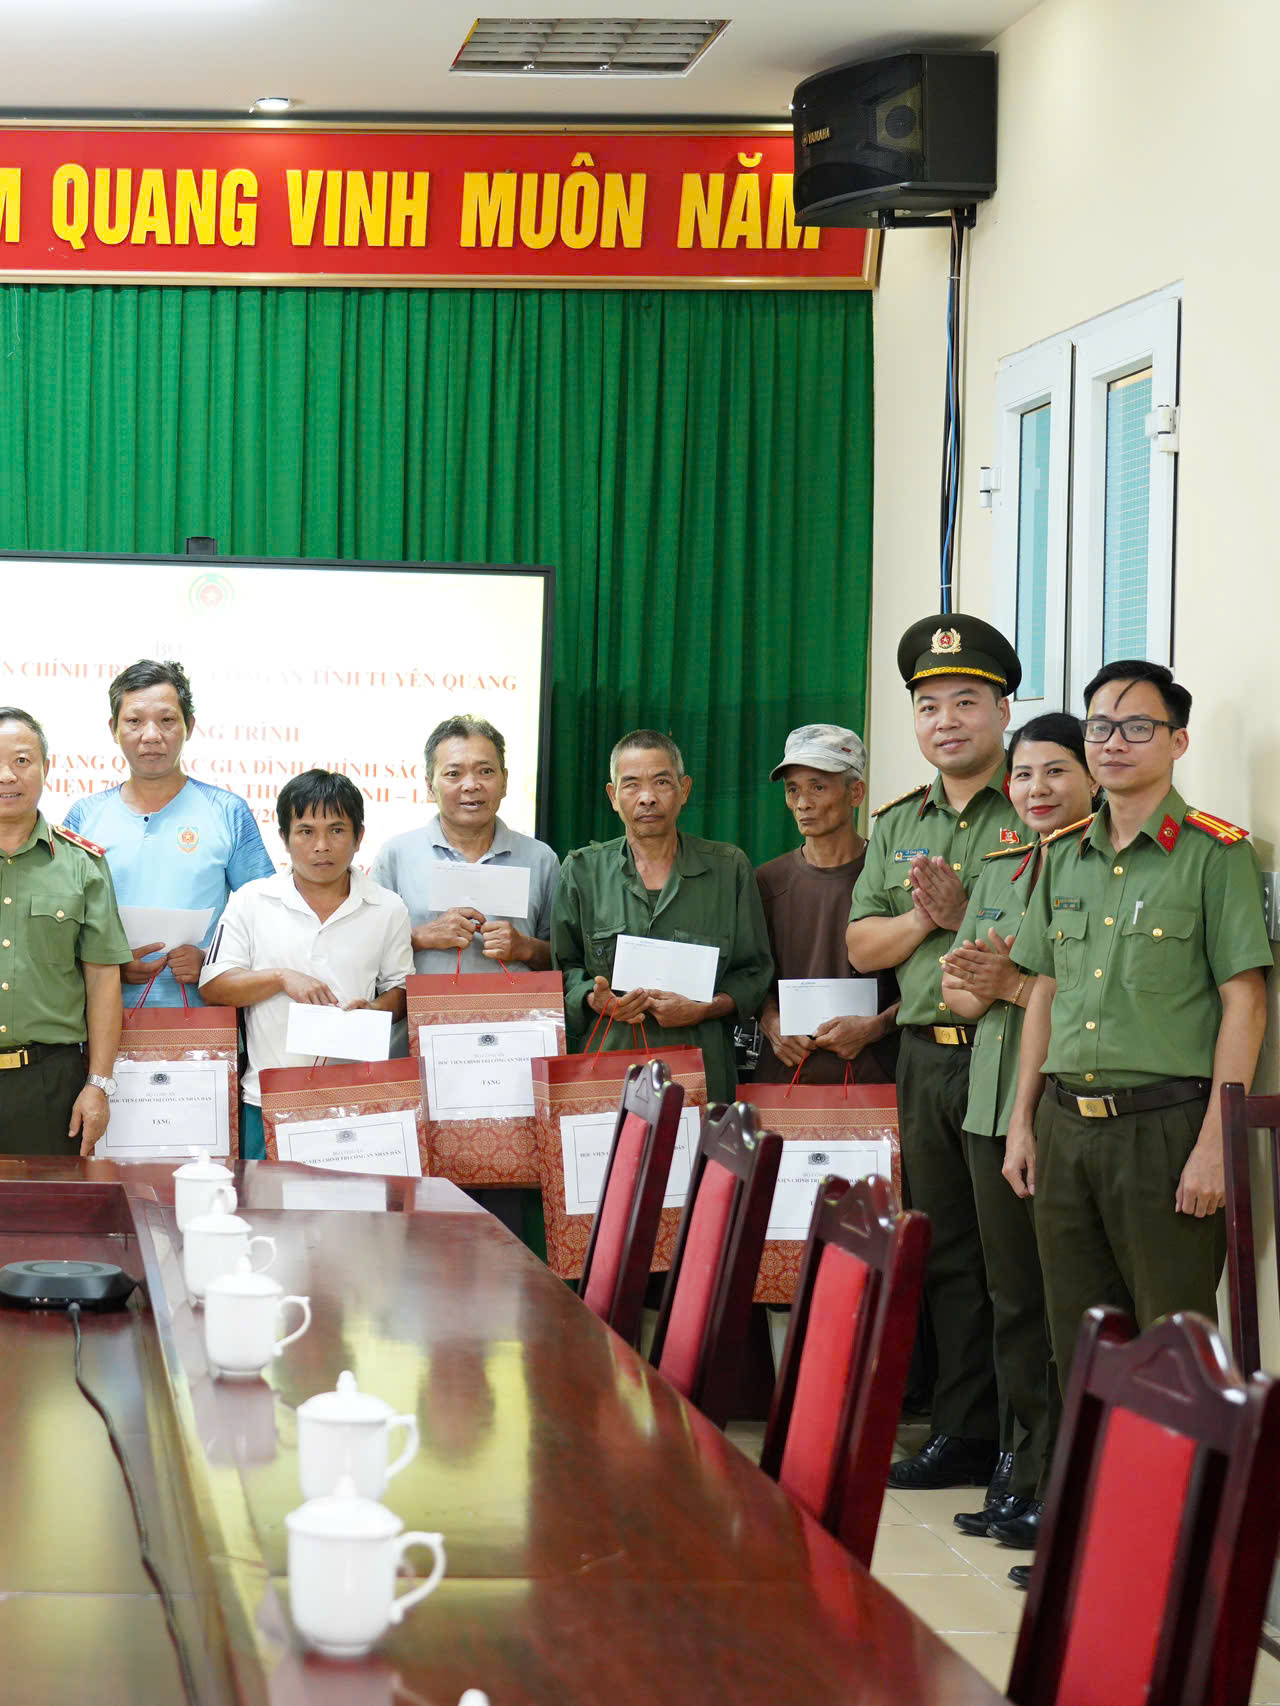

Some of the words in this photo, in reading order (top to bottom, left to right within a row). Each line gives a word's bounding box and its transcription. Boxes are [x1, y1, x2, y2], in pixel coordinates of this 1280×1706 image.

[53, 163, 259, 250] QUANG
[287, 171, 430, 248] VINH
[460, 152, 647, 250] MUÔN
[677, 152, 821, 249] NĂM
[21, 657, 91, 679] CHÍNH
[442, 673, 517, 692] QUANG
[210, 758, 248, 775] GIA
[384, 759, 424, 780] SÁC
